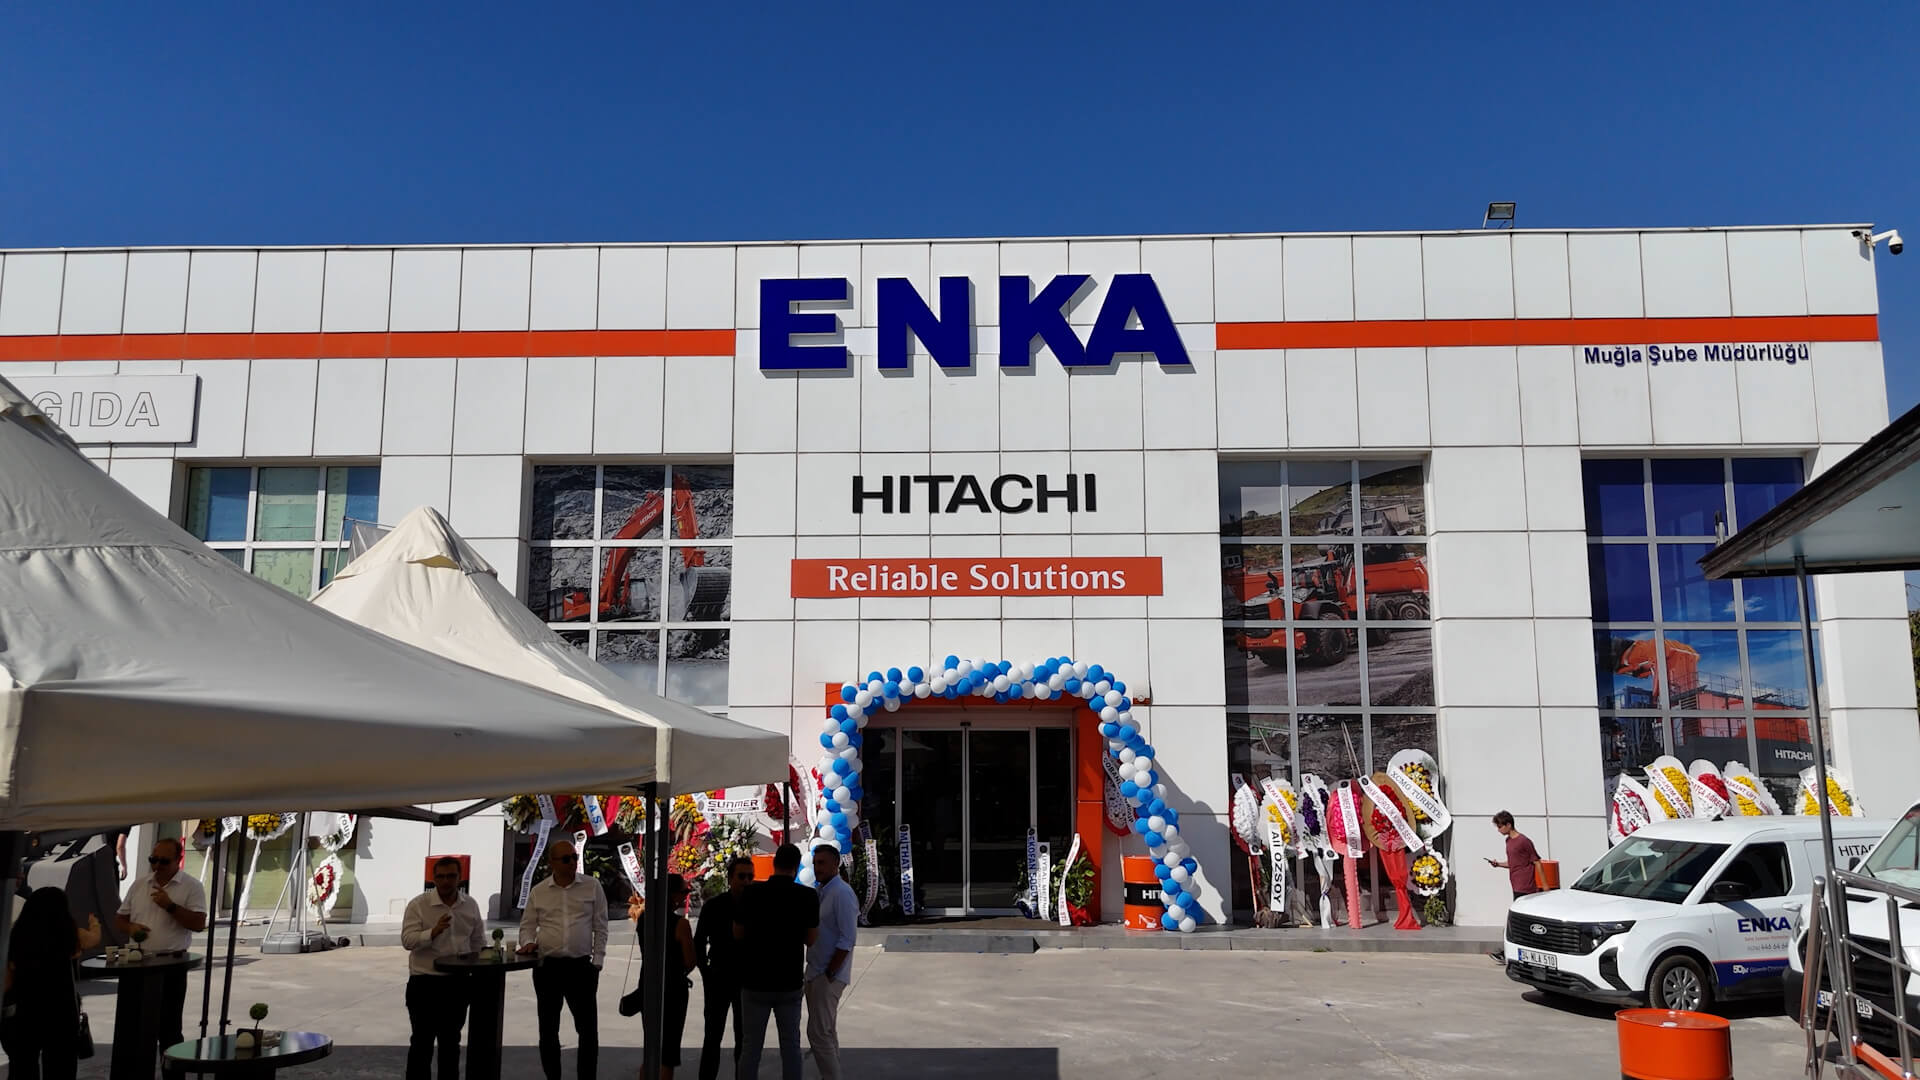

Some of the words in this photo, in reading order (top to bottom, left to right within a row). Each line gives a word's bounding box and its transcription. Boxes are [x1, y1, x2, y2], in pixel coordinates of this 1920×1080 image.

[760, 273, 1192, 370] ENKA
[1584, 345, 1642, 367] Muğla
[1648, 343, 1698, 366] Şube
[1703, 342, 1810, 364] Müdürlüğü
[852, 474, 1097, 513] HITACHI
[828, 565, 959, 591] Reliable
[969, 563, 1127, 590] Solutions
[1775, 749, 1813, 760] HITACHI
[1412, 789, 1443, 819] TÜRKİYE
[1737, 916, 1792, 932] ENKA
